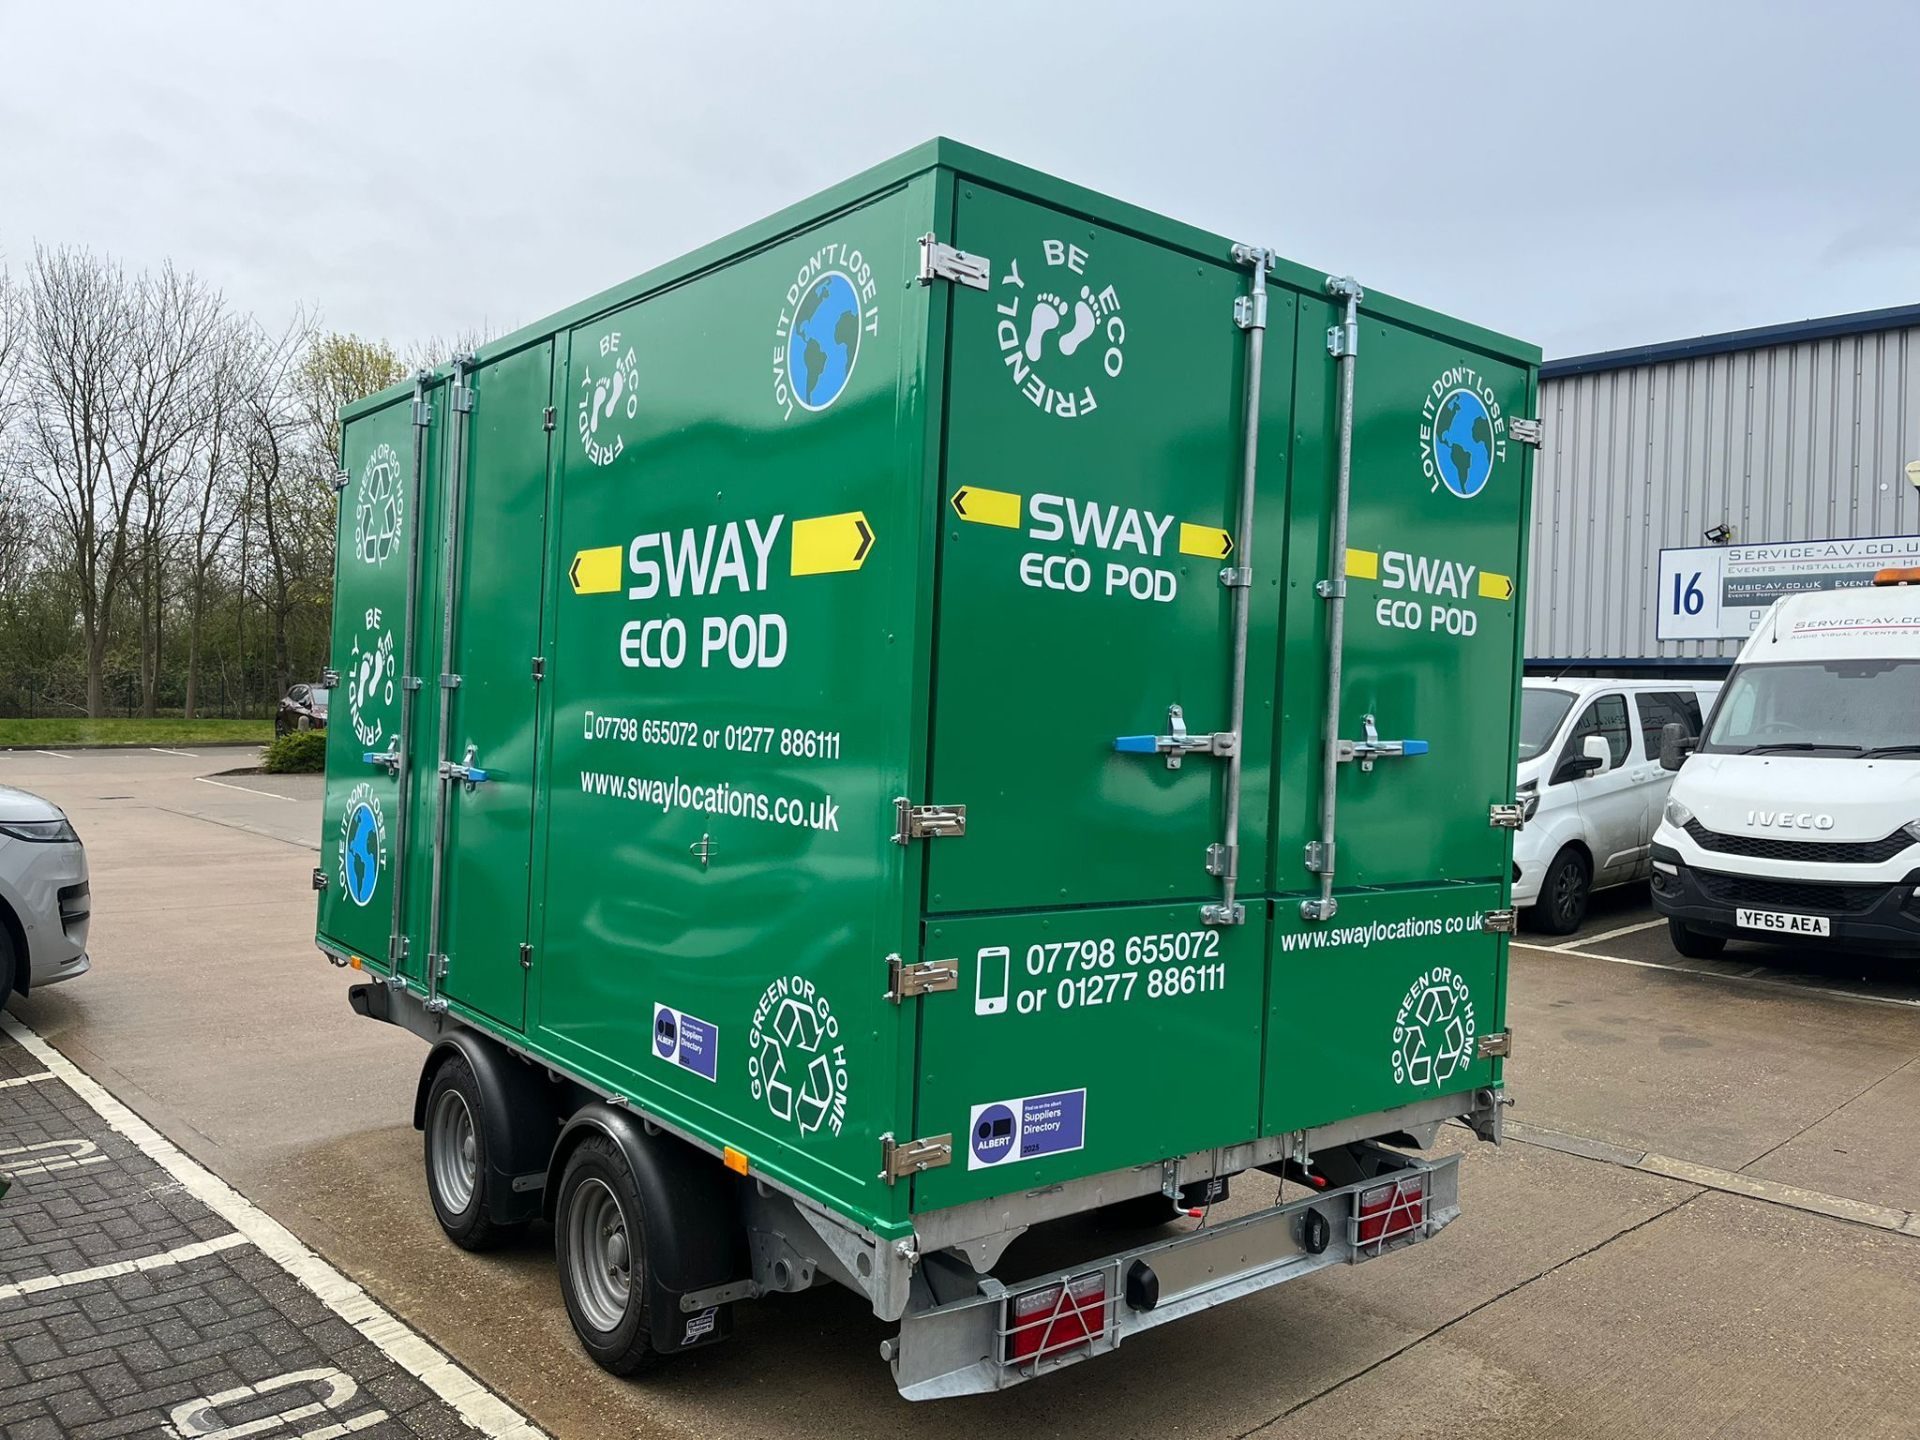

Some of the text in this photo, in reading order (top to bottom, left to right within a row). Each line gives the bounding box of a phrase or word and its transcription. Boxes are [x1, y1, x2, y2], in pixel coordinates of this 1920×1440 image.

[773, 243, 878, 422] LOVE IT DON'T LOSE IT
[997, 239, 1125, 417] BE ECO FRIENDLY
[577, 332, 638, 467] BE ECO FRIENDLY
[377, 443, 390, 460] OR
[1420, 367, 1506, 493] LOVE IT DON'T LOSE IT
[357, 450, 377, 519] GREEN
[389, 450, 400, 478] GO
[392, 479, 404, 554] HOME
[1029, 493, 1174, 556] SWAY
[628, 514, 784, 600] SWAY
[1019, 552, 1177, 602] ECO POD
[1382, 551, 1476, 600] SWAY
[1376, 598, 1477, 636] ECO POD
[1673, 572, 1704, 615] 16
[620, 613, 787, 668] ECO POD
[349, 607, 394, 747] BE ECO FRIENDLY
[595, 716, 840, 760] 07798 655072 or 01277 886111
[580, 770, 840, 832] www.swaylocations.co.uk
[1747, 810, 1835, 830] IVECO
[338, 783, 387, 901] LOVE IT DON'T LOSE IT
[1743, 911, 1823, 933] YF65 AEA
[1026, 930, 1219, 976] 07798 655072
[1016, 963, 1225, 1014] or 01277 886111
[657, 1034, 674, 1047] ALBERT
[1391, 966, 1475, 1084] GO GREEN OR GO HOME
[748, 975, 848, 1137] GO GREEN OR GO HOME
[1024, 1109, 1062, 1122] Suppliers
[1024, 1122, 1060, 1134] Directory
[978, 1136, 1011, 1151] ALBERT
